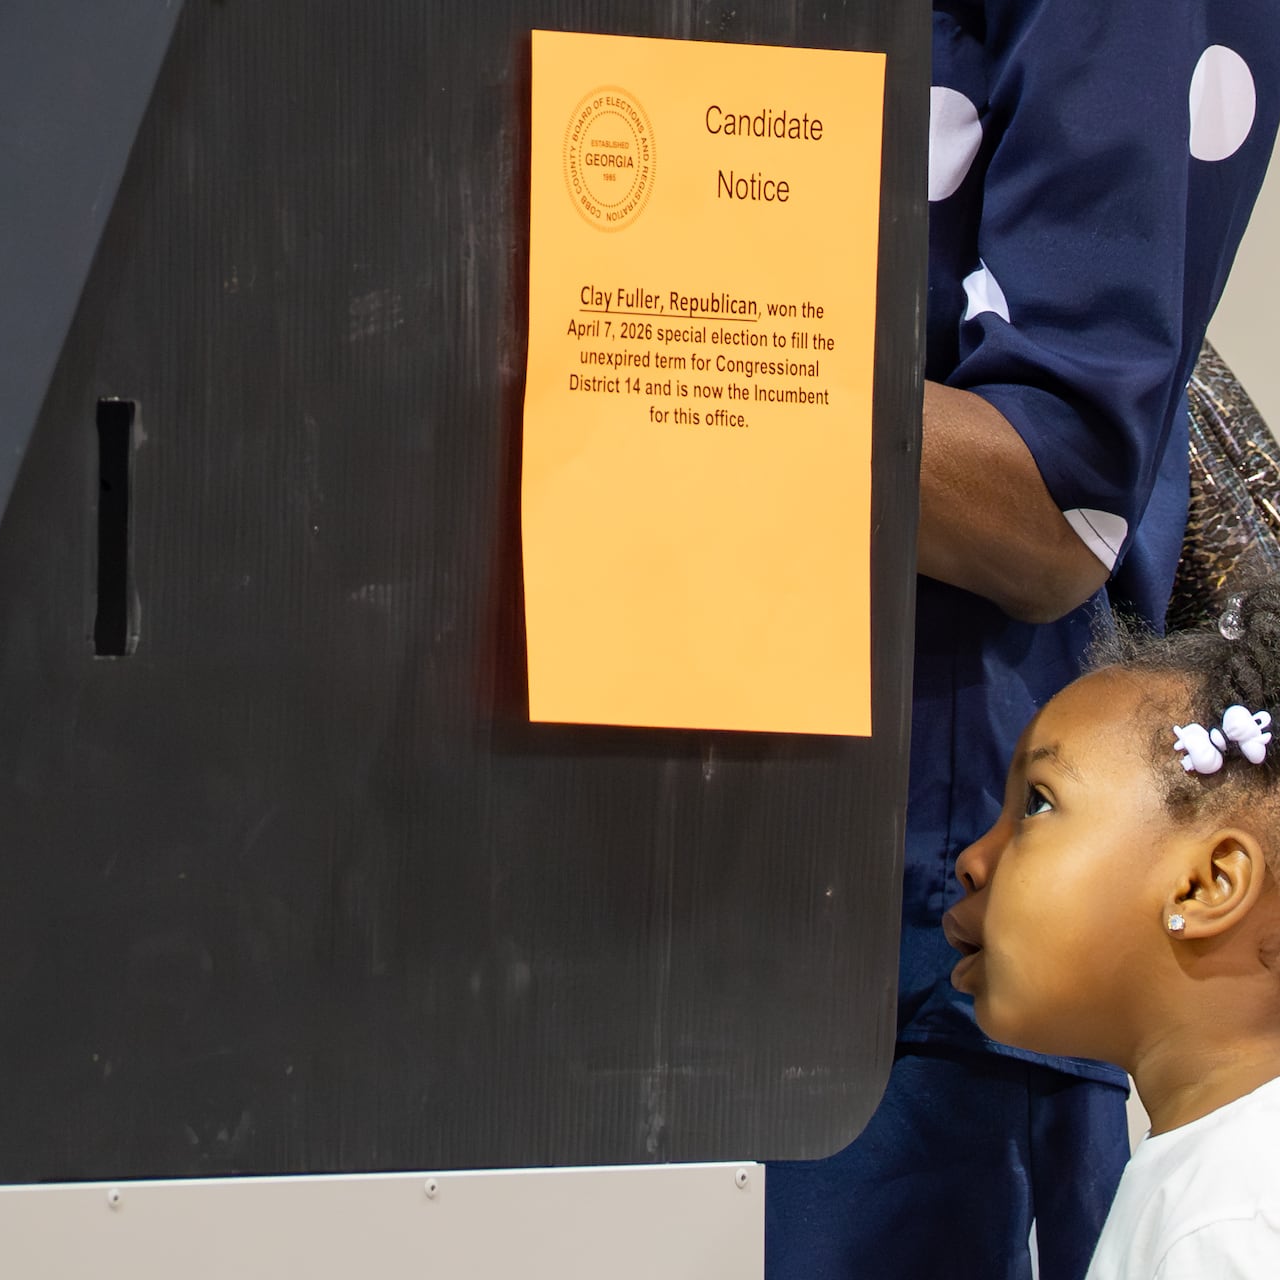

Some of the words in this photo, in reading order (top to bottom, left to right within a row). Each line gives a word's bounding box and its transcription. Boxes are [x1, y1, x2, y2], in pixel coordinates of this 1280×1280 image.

[593, 98, 603, 110] OF
[605, 96, 645, 134] ELECTIONS
[572, 106, 593, 142] BOARD
[705, 105, 823, 141] Candidate
[591, 139, 630, 150] ESTABLISHED
[641, 137, 650, 162] AND
[569, 145, 582, 194] COUNTY
[585, 153, 634, 169] GEORGIA
[606, 166, 649, 222] REGISTRATION
[717, 169, 790, 202] Notice
[581, 195, 602, 219] COBB
[580, 285, 613, 312] Clay
[617, 287, 665, 313] Fuller,
[670, 291, 762, 319] Republican,
[767, 302, 797, 318] won
[802, 301, 824, 319] the
[567, 319, 600, 340] April
[604, 321, 616, 341] 7,
[620, 322, 653, 340] 2026
[657, 325, 707, 345] special
[711, 327, 768, 347] election
[773, 332, 787, 348] to
[791, 331, 808, 349] fill
[813, 333, 835, 351] the
[580, 349, 651, 370] unexpired
[655, 352, 686, 370] term
[691, 353, 712, 371] for
[716, 355, 820, 378] Congressional
[569, 374, 621, 394] District
[625, 377, 641, 395] 14
[645, 380, 672, 396] and
[676, 380, 689, 397] is
[693, 384, 724, 399] now
[727, 383, 750, 401] the
[754, 384, 830, 405] Incumbent
[649, 405, 669, 423] for
[674, 407, 700, 425] this
[705, 409, 749, 428] office.
